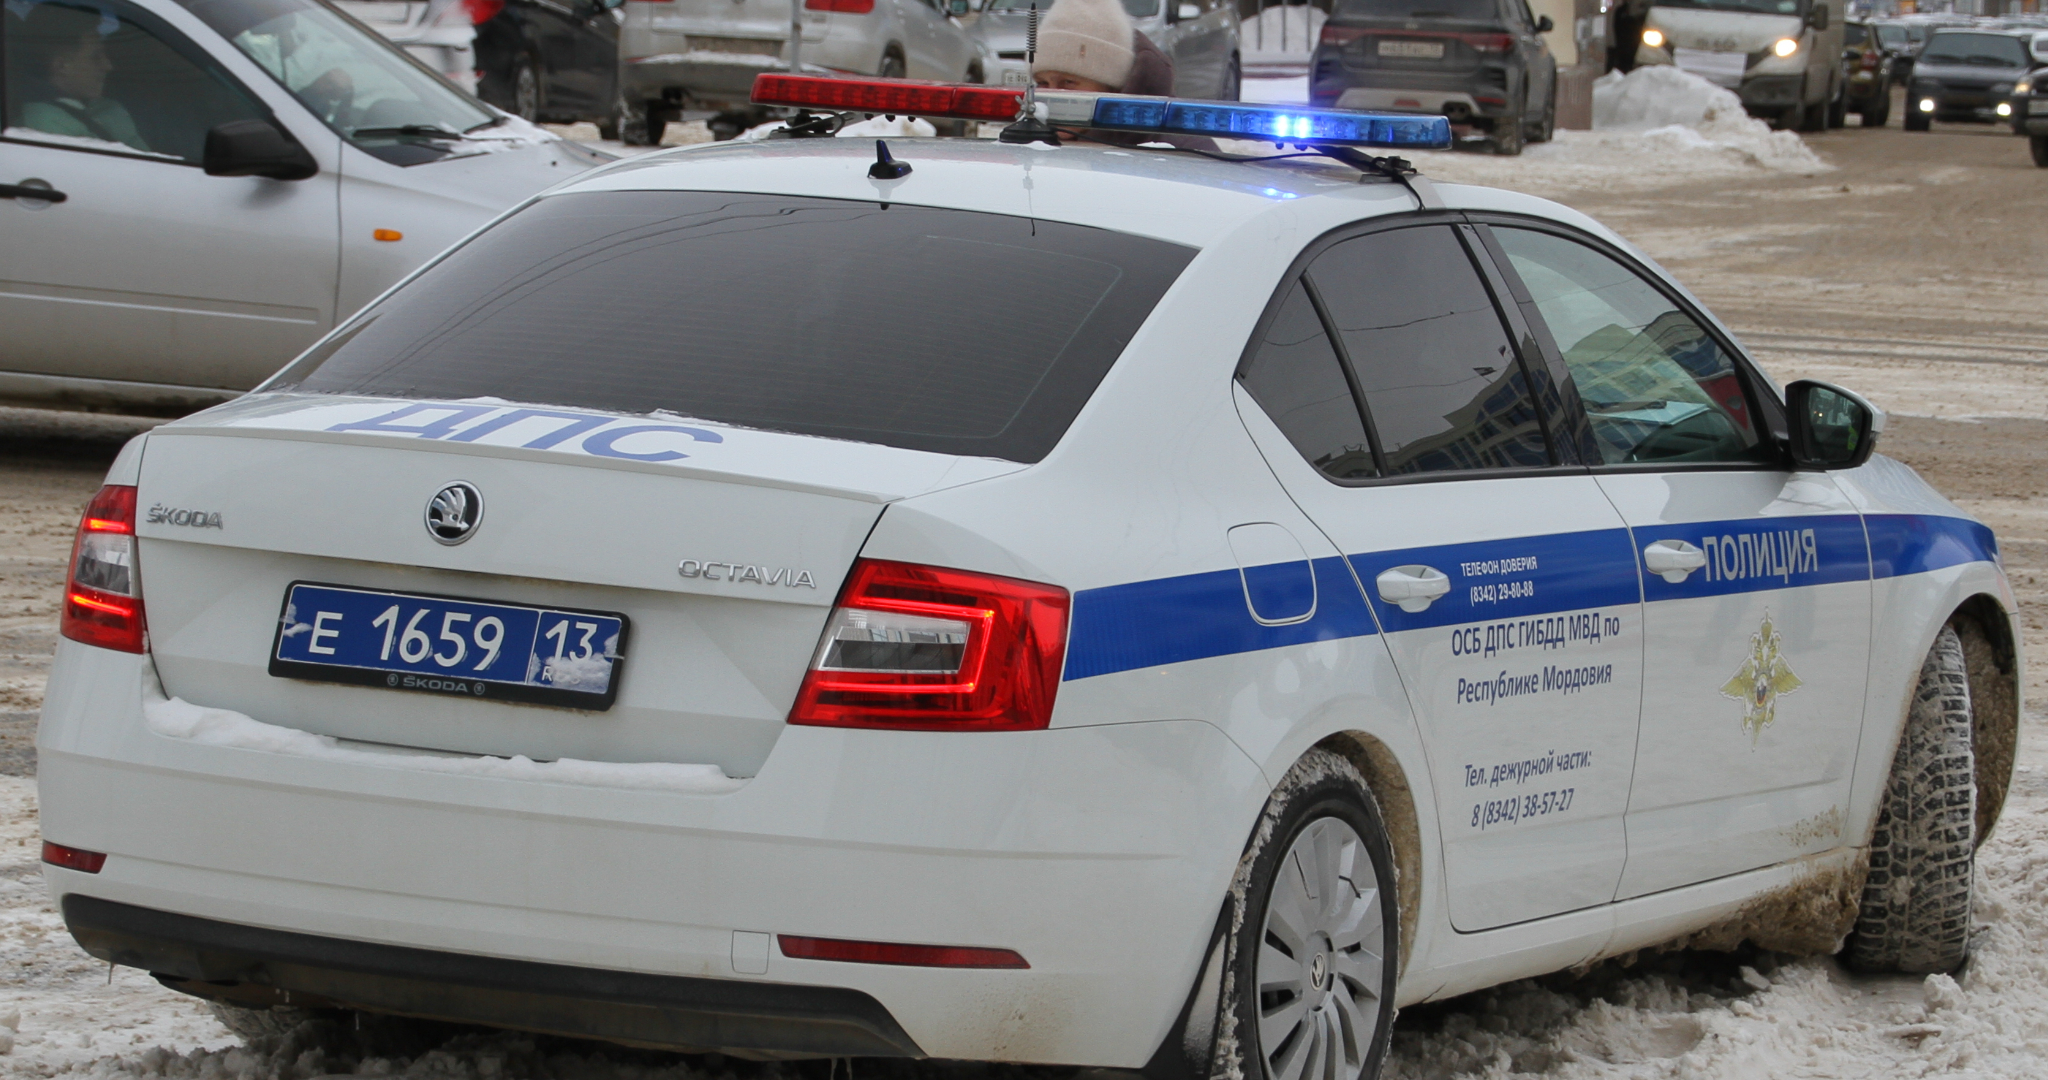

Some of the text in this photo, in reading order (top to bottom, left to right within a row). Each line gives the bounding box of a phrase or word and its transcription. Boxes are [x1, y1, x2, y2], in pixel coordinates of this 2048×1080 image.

[325, 402, 724, 462] ДПС
[146, 502, 224, 530] ŠKODA
[678, 558, 816, 589] OCTAVIA
[1460, 556, 1538, 577] ТЕЛЕФОН ДОВЕРИЯ
[1702, 528, 1818, 584] ПОЛИЦИЯ
[1470, 580, 1534, 607] (8342) 29-80-88
[372, 604, 505, 671] 1659
[545, 620, 598, 664] 13
[1452, 612, 1620, 658] ОСБ ДПС ГИБДД МВД по
[403, 675, 468, 693] ŠKODA
[1457, 664, 1612, 706] Республике Мордовия
[1465, 749, 1592, 788] Тел. дежурной части:
[1471, 788, 1575, 831] 8 (8342) 38-57-27
